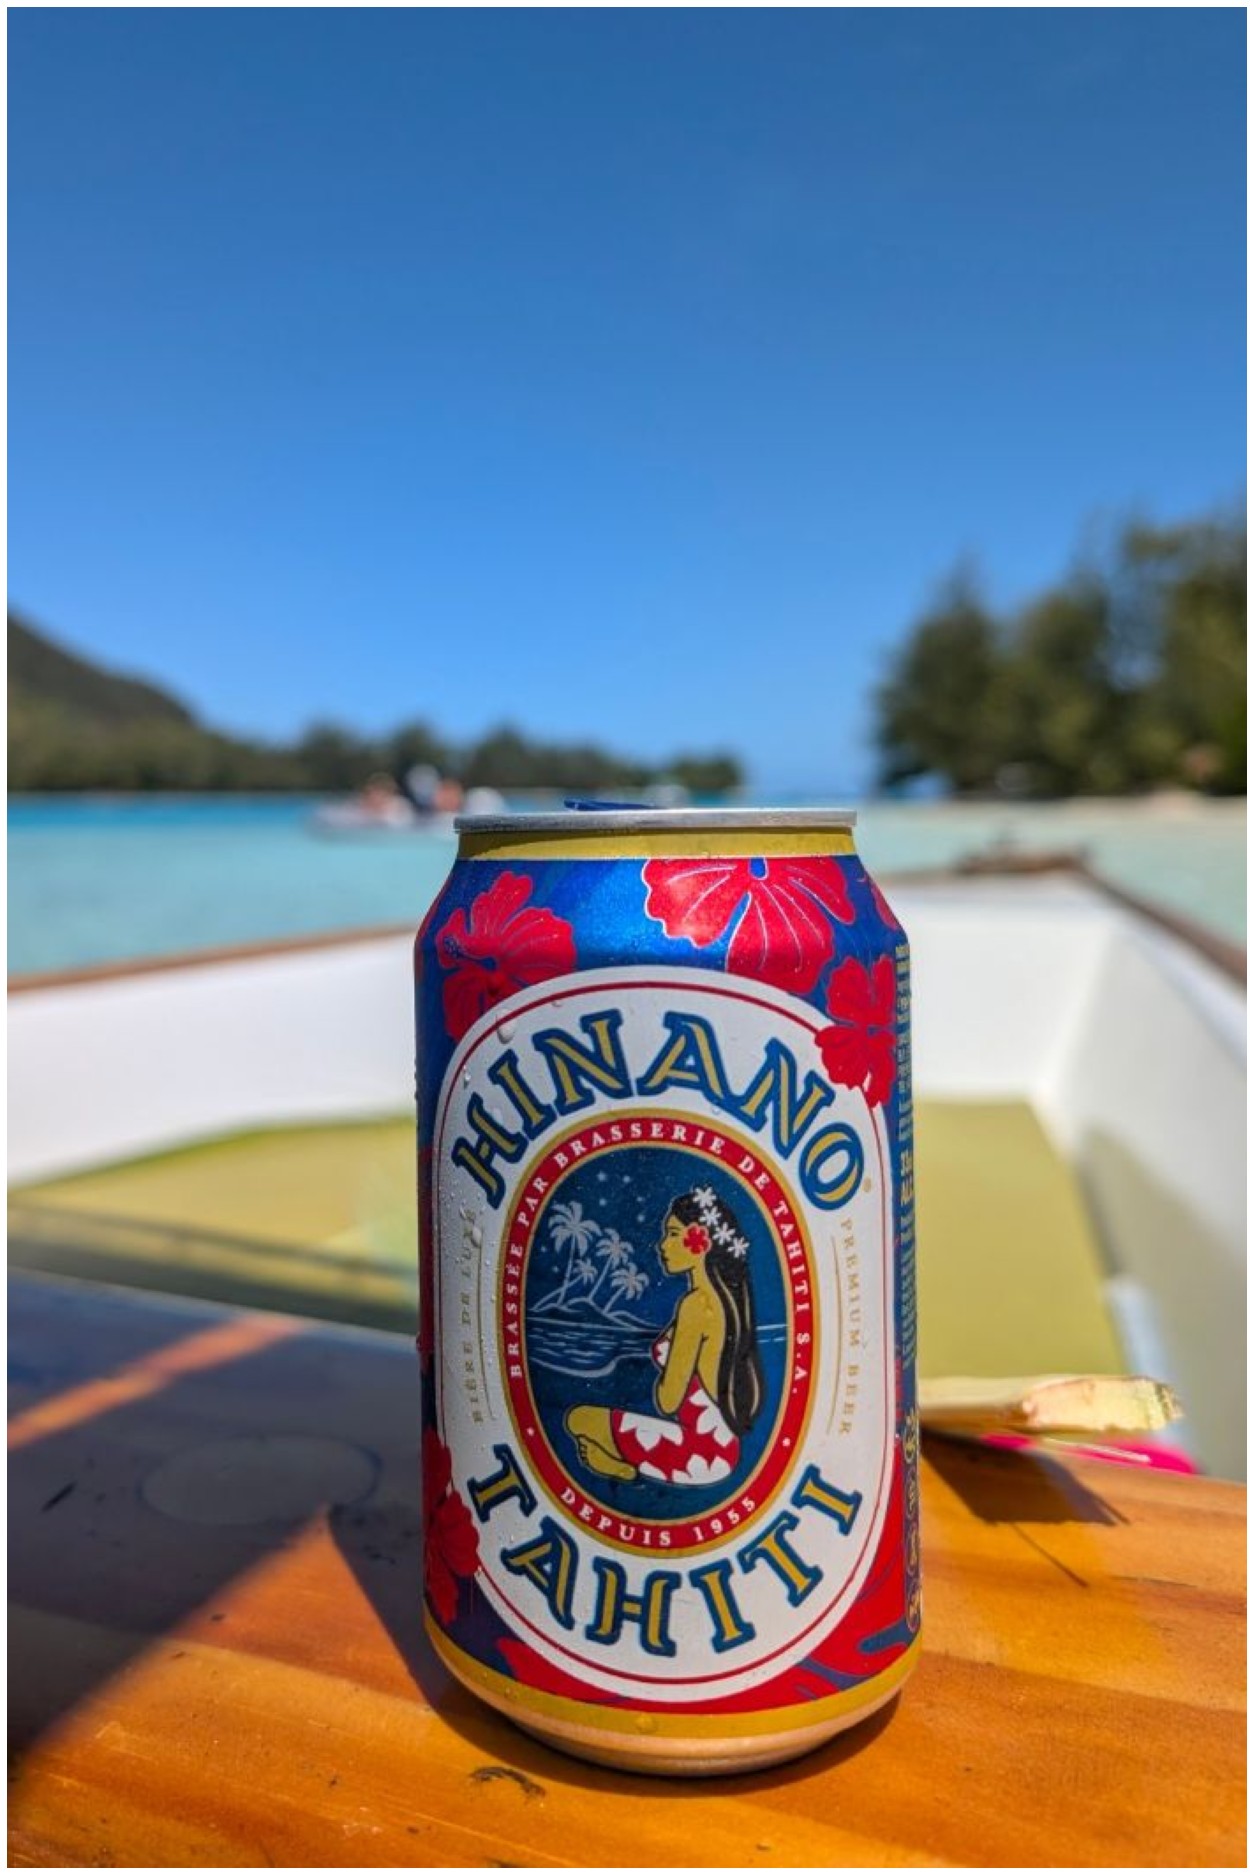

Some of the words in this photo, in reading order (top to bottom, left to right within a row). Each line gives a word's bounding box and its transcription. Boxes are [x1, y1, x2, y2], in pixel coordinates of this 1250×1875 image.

[451, 1009, 864, 1210] HINANO
[506, 1243, 524, 1378] BRASSÉE
[517, 1176, 549, 1227] PAR
[554, 1121, 725, 1168] BRASSERIE
[738, 1155, 770, 1190] DE
[772, 1201, 810, 1311] TAHITI
[792, 1332, 811, 1394] S.A.
[841, 1218, 860, 1346] PREMIUM
[839, 1364, 860, 1434] BEER
[467, 1444, 863, 1658] TAHITI
[561, 1487, 671, 1546] DEPUIS
[693, 1497, 756, 1542] 1955
